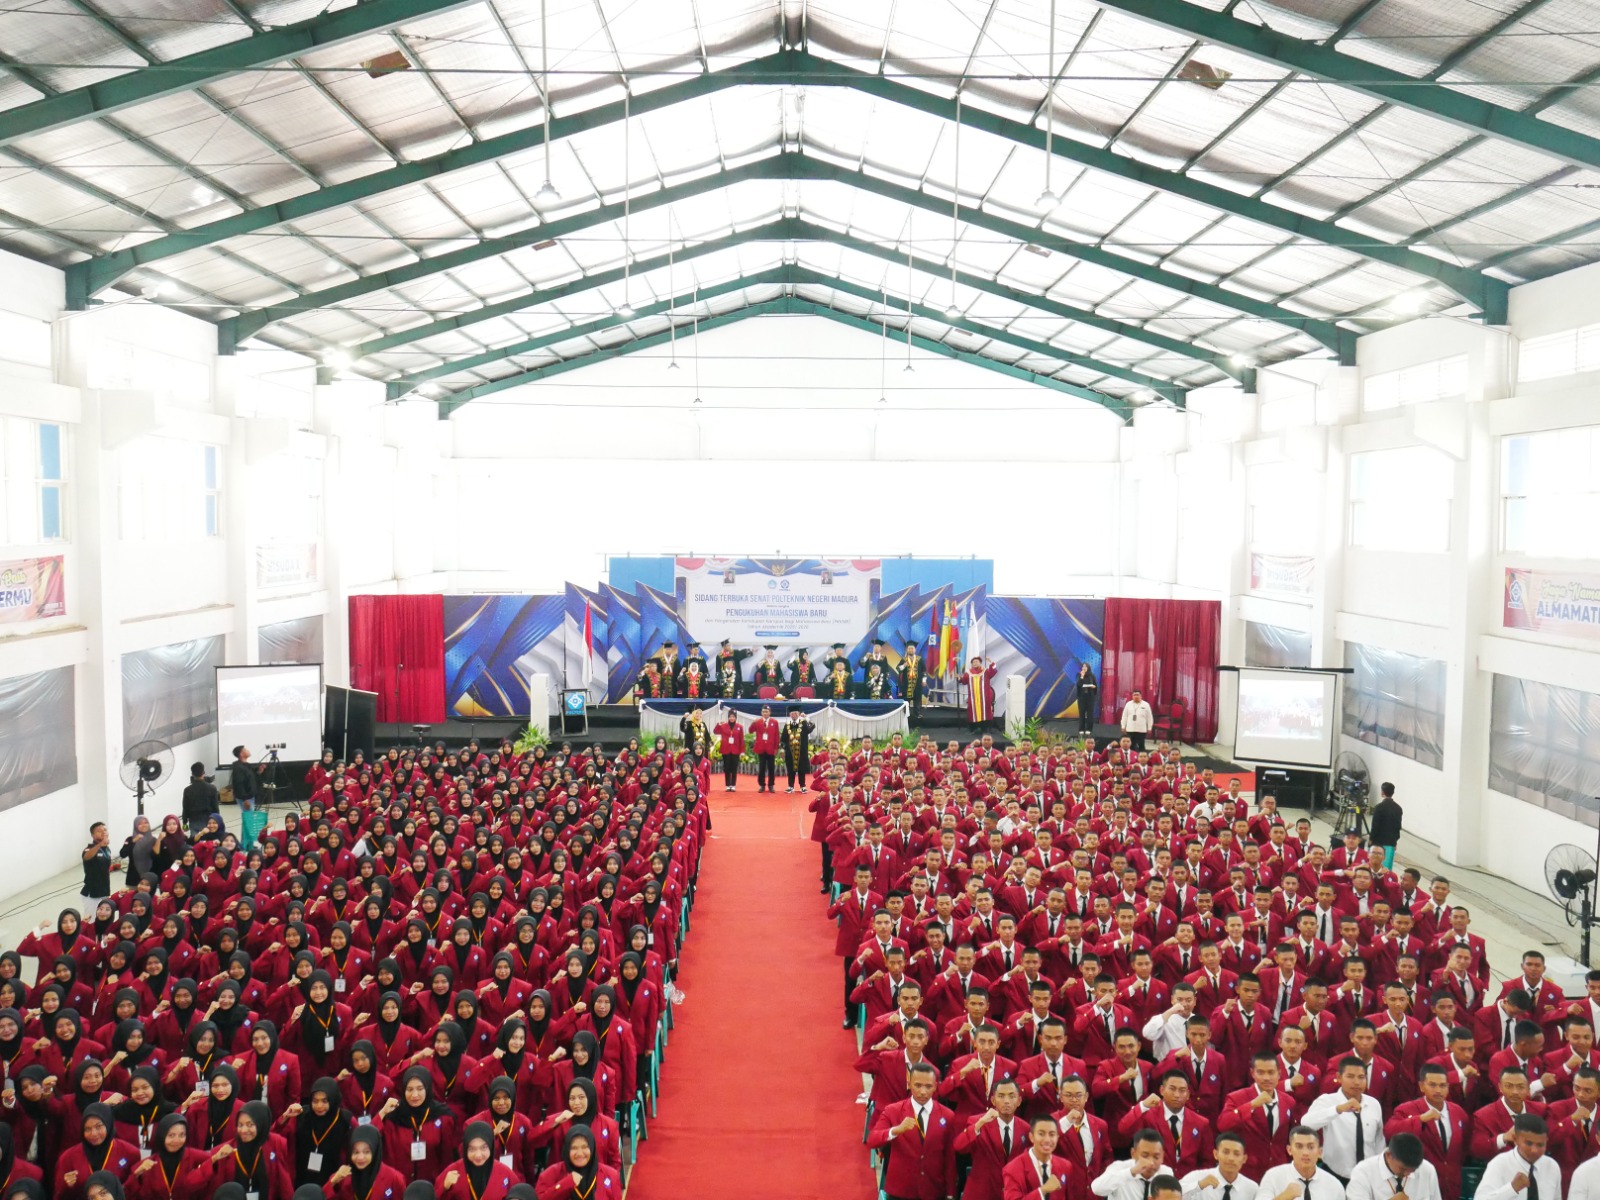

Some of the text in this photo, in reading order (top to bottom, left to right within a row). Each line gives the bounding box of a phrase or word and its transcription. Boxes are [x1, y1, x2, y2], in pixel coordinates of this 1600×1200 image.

[694, 593, 718, 602] SIDANG
[720, 594, 749, 602] TERBUKA
[750, 594, 770, 602] SENAT
[807, 595, 830, 603] NEGERI
[831, 595, 858, 603] MADURA
[726, 608, 828, 617] PENGUKUHAN MAHASISWA BARU
